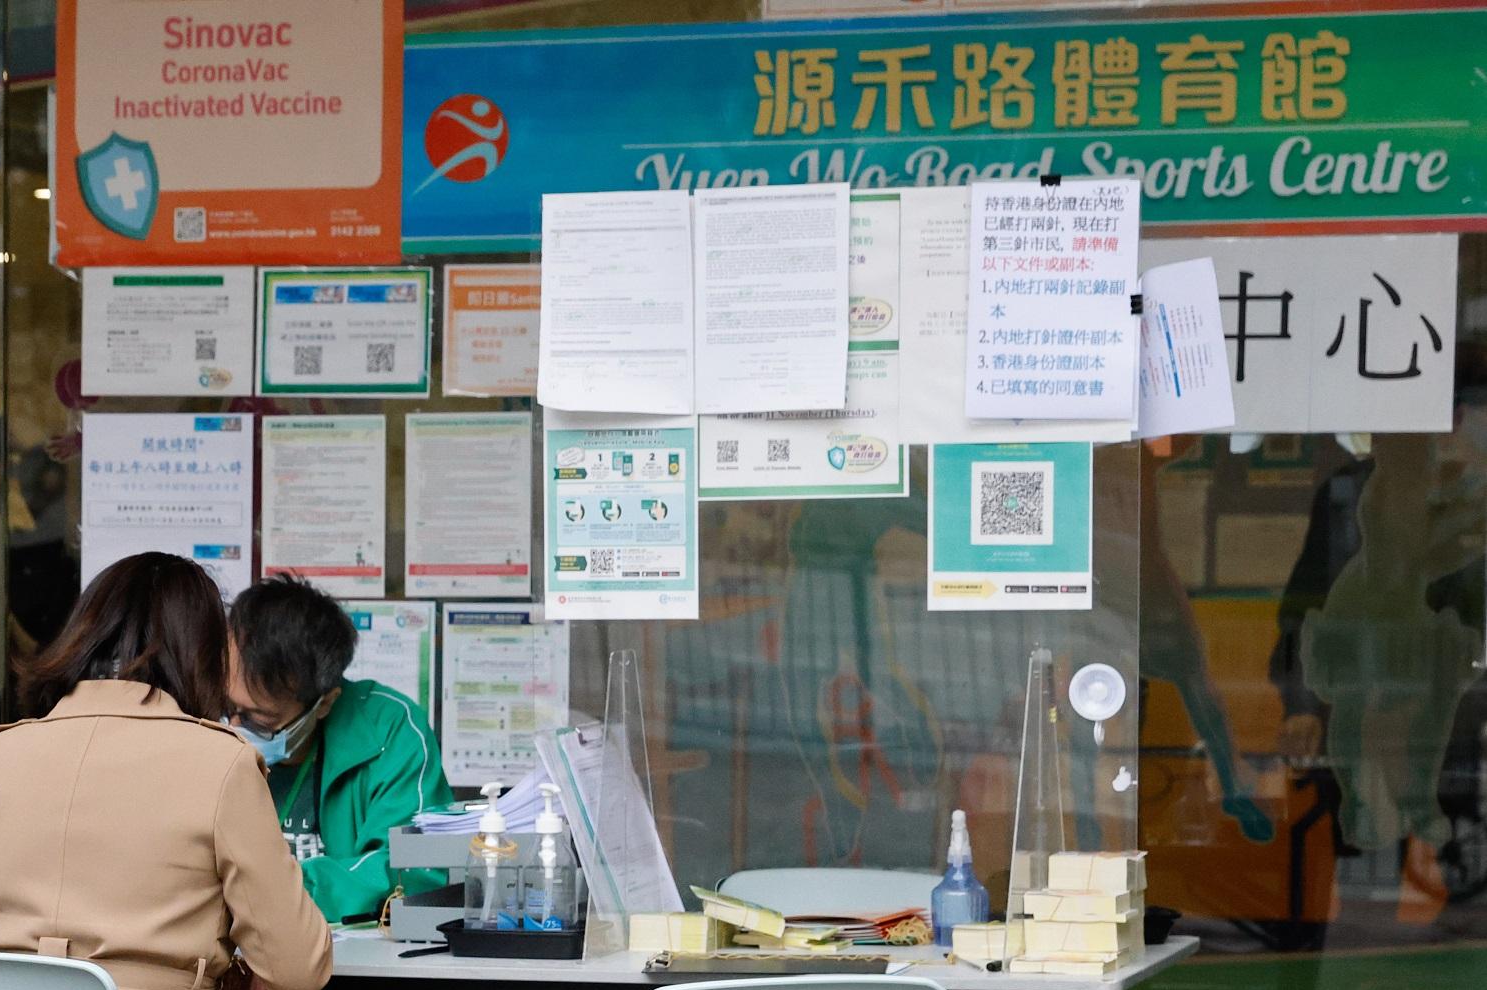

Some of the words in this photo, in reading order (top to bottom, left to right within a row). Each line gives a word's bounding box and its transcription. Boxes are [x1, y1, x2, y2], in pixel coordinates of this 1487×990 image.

[163, 16, 293, 50] Sinovac
[161, 58, 289, 84] CoronaVac
[752, 29, 1352, 136] 源禾路體育館
[114, 94, 245, 119] Inactivated
[250, 90, 343, 116] Vaccine
[1269, 135, 1451, 197] Centre
[984, 196, 1124, 212] 持香港身份證在內地
[990, 303, 1006, 320] 本
[1219, 271, 1443, 382] 中心
[777, 409, 823, 419] November
[598, 453, 603, 462] 1
[649, 453, 656, 461] 2
